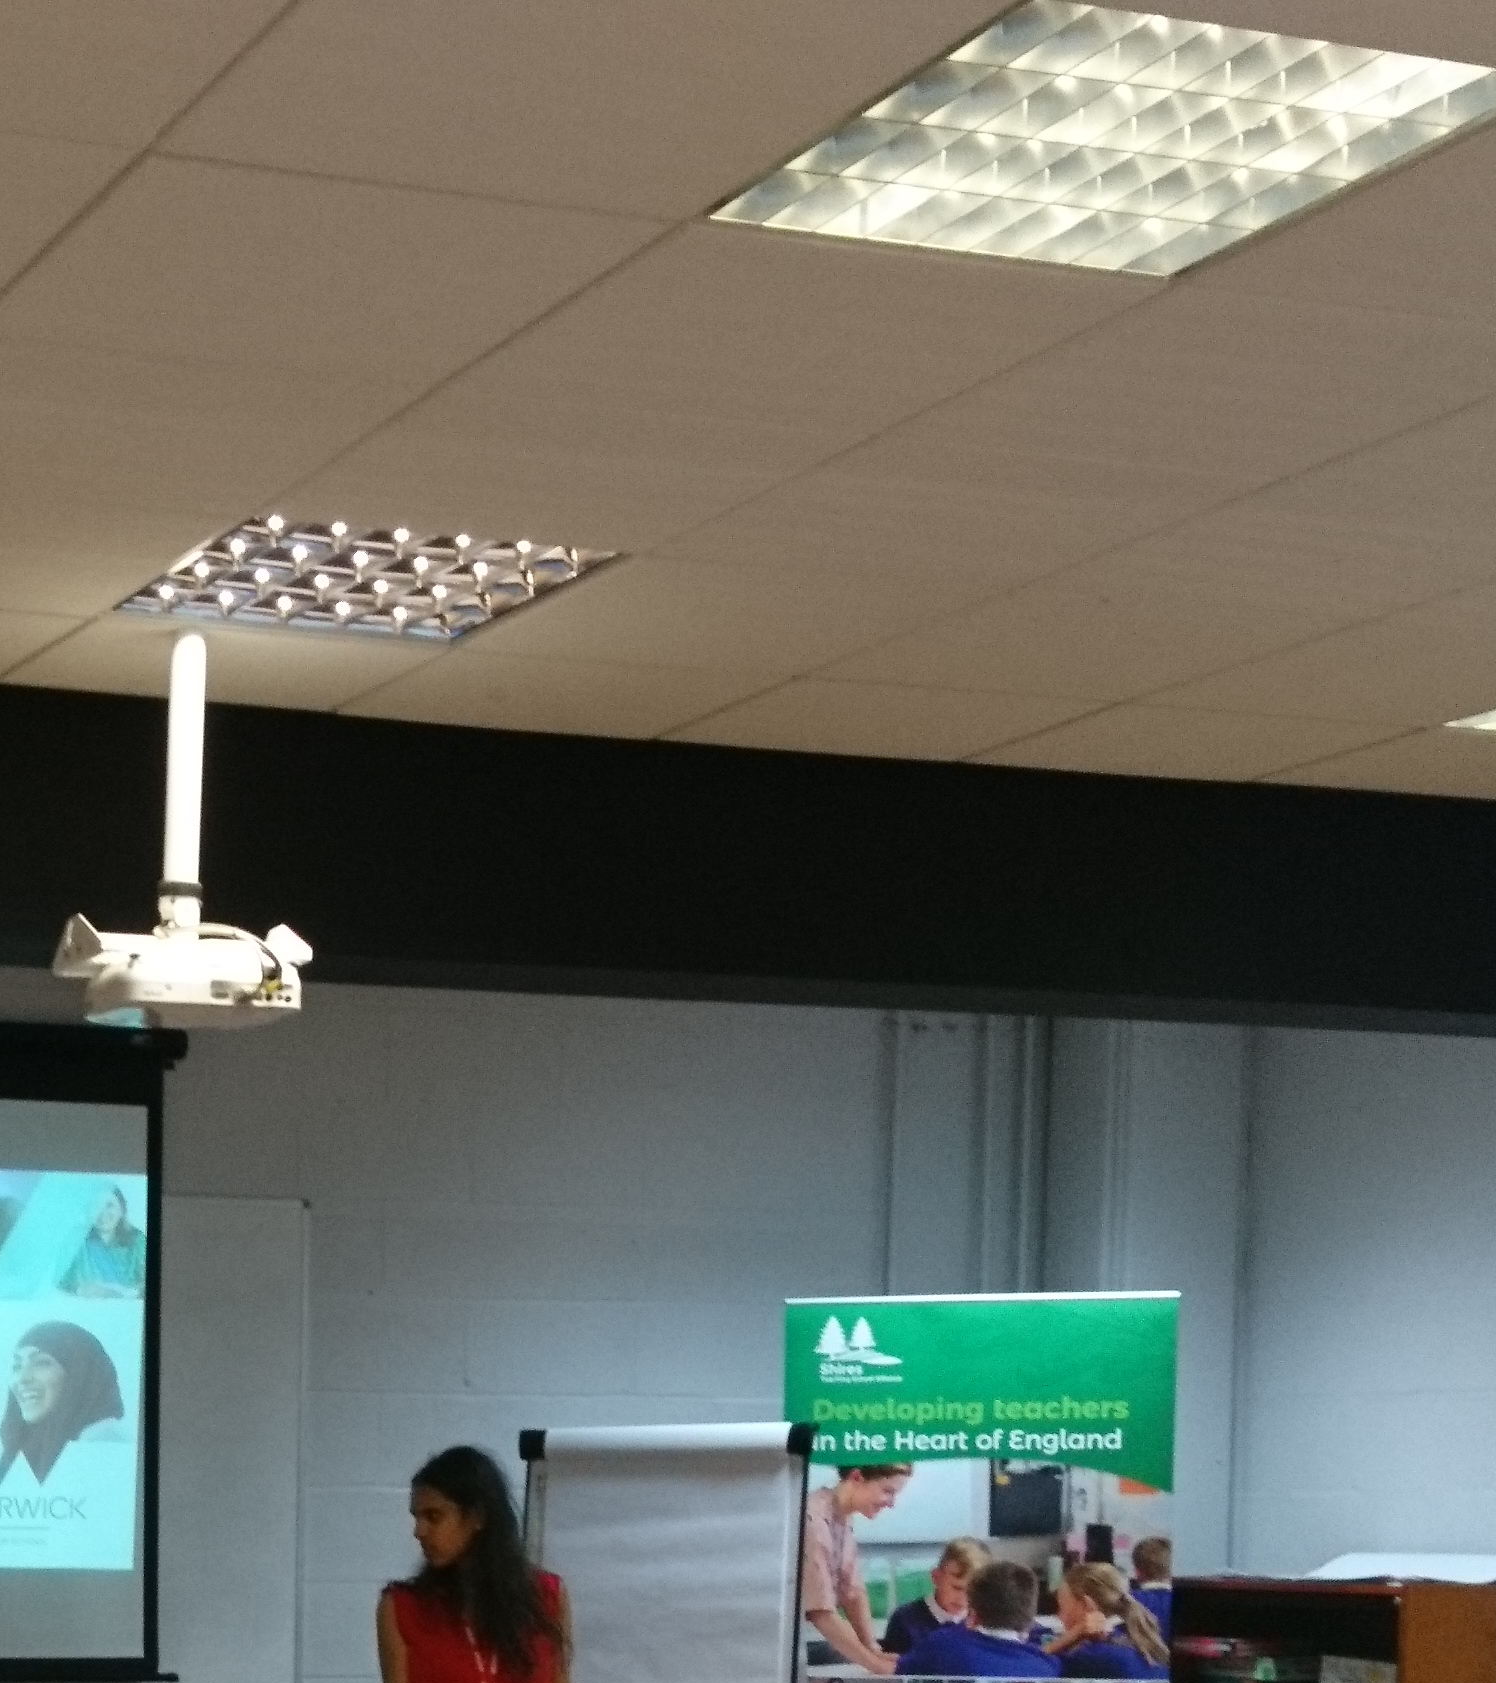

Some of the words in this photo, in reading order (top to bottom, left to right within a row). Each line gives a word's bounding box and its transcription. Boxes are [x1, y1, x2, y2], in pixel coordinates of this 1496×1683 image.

[820, 1362, 863, 1375] Shires
[813, 1397, 985, 1425] Developing
[993, 1397, 1129, 1421] teachers
[812, 1431, 836, 1450] in
[843, 1429, 887, 1451] the
[894, 1429, 968, 1451] Heart
[975, 1428, 1004, 1450] of
[1008, 1427, 1123, 1455] England
